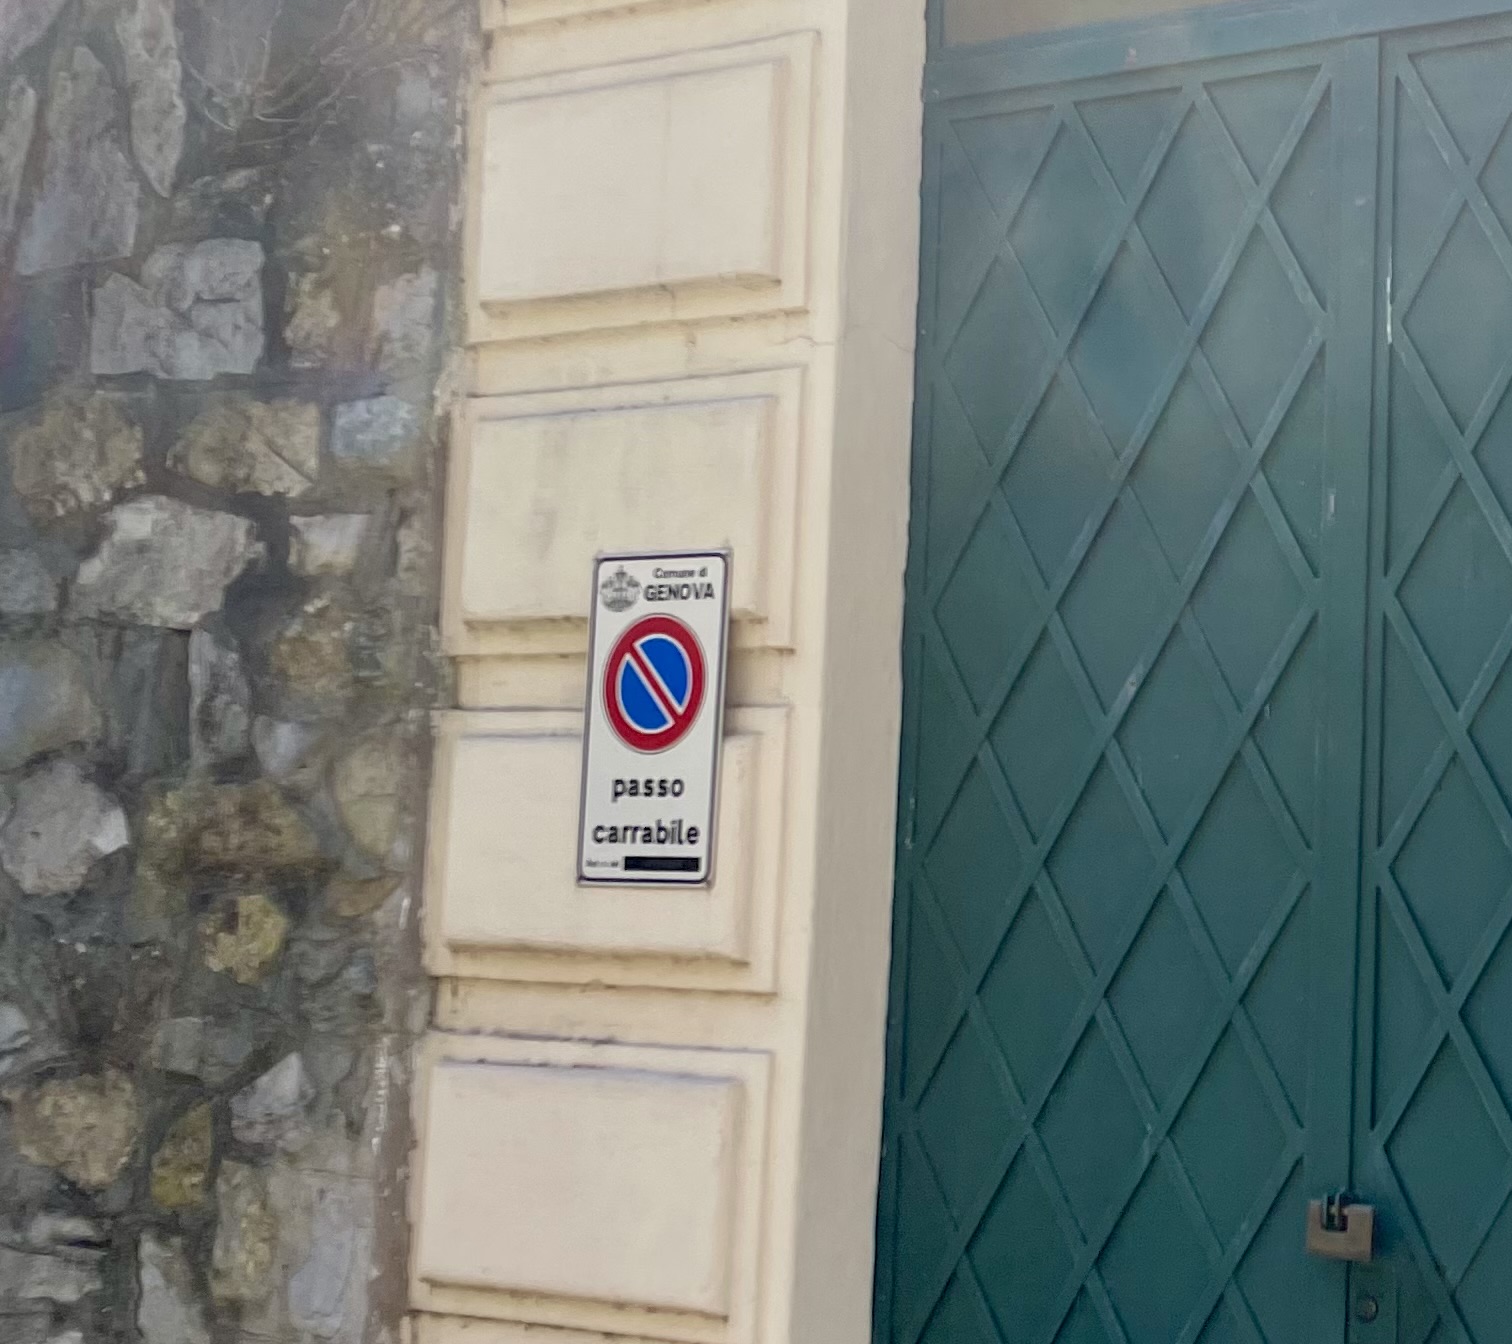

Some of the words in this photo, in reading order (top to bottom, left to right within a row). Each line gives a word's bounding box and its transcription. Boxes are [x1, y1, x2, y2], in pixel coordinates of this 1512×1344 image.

[643, 583, 716, 601] GENOVA
[611, 778, 684, 803] passo
[592, 818, 700, 845] carrabile
